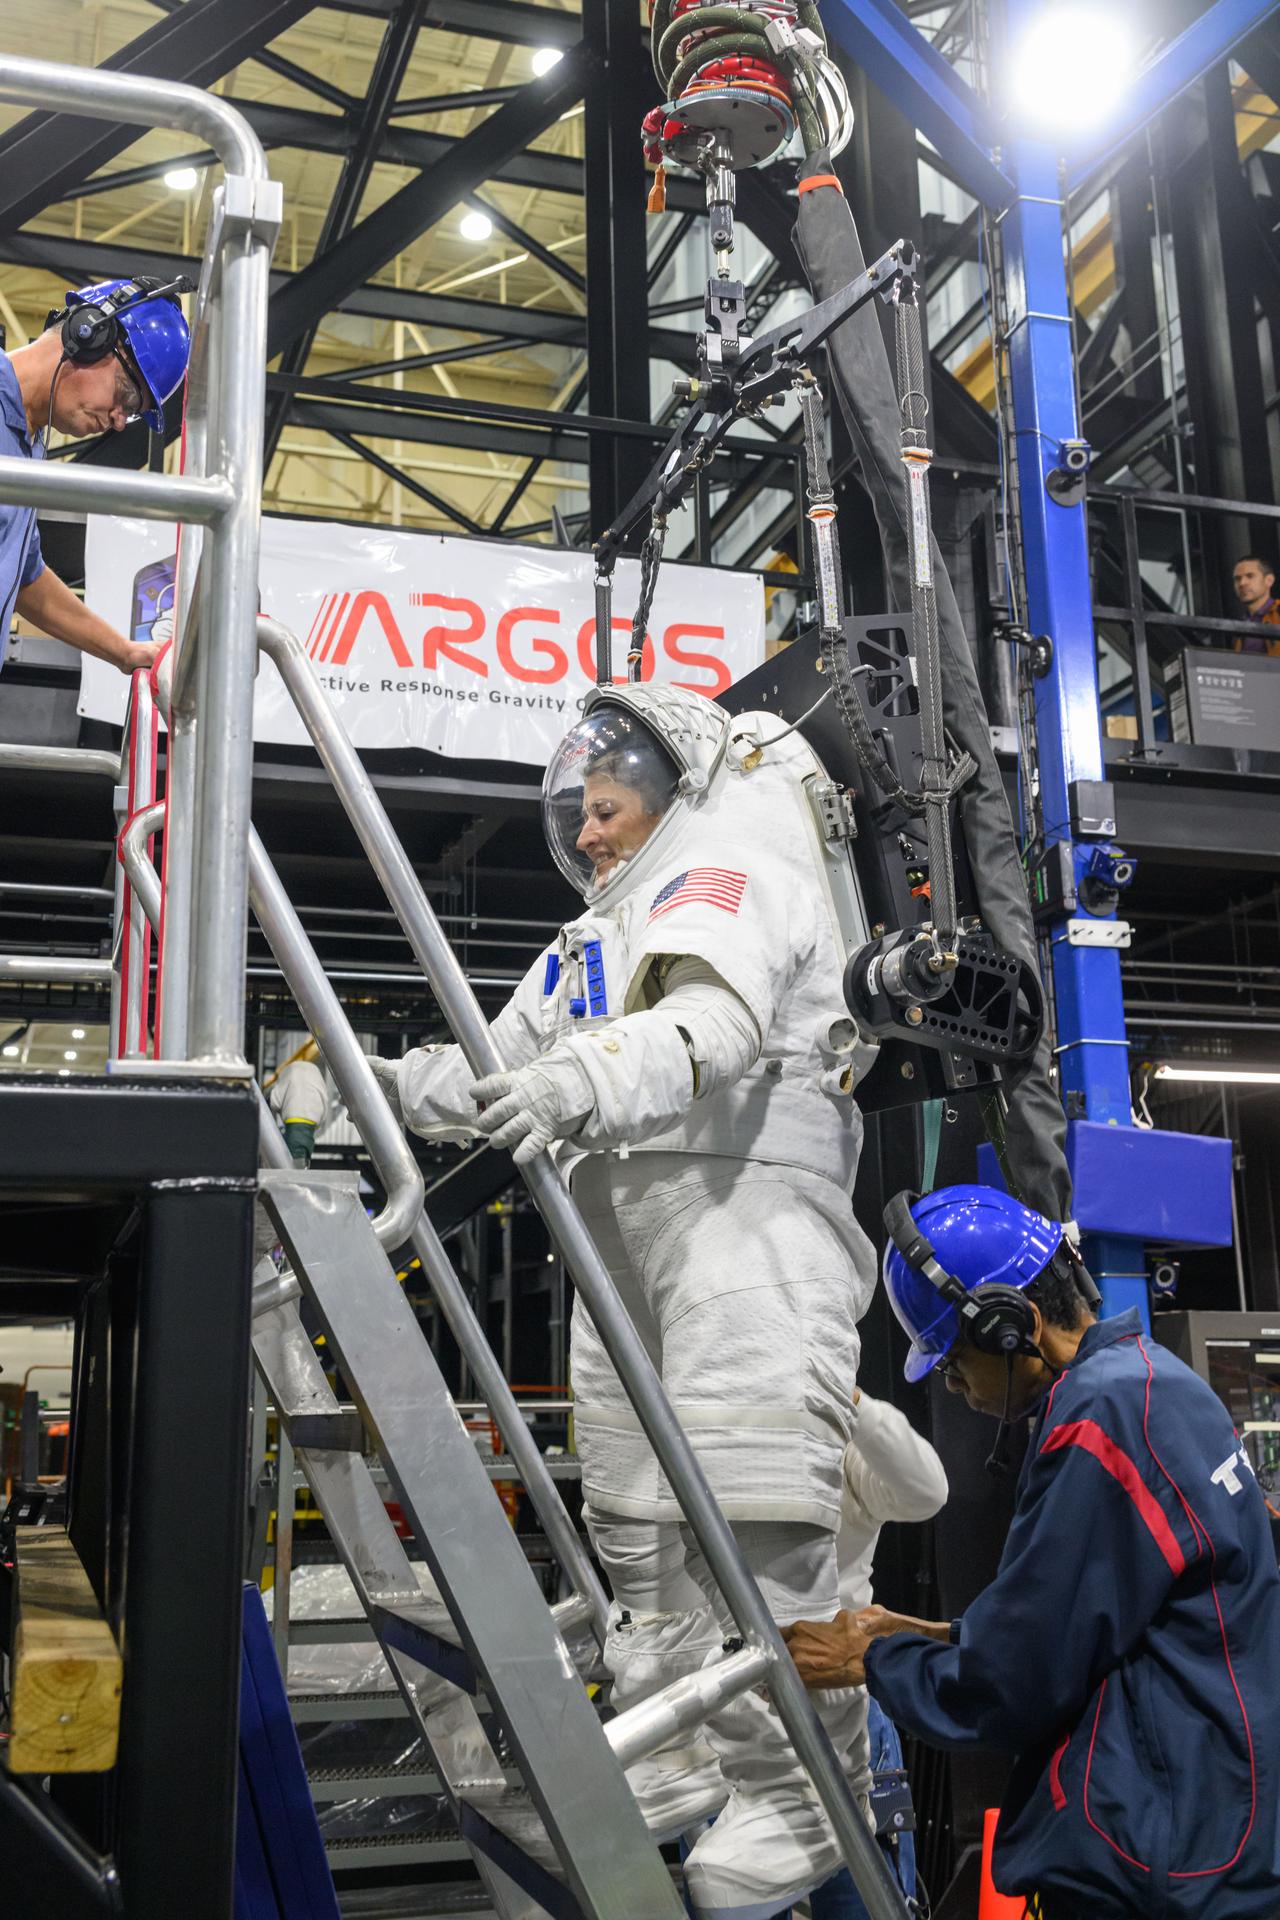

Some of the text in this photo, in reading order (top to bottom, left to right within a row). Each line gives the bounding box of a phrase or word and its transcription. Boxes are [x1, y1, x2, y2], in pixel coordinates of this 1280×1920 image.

[305, 589, 732, 700] ARGOS
[381, 679, 479, 702] Response
[489, 690, 567, 713] Gravity
